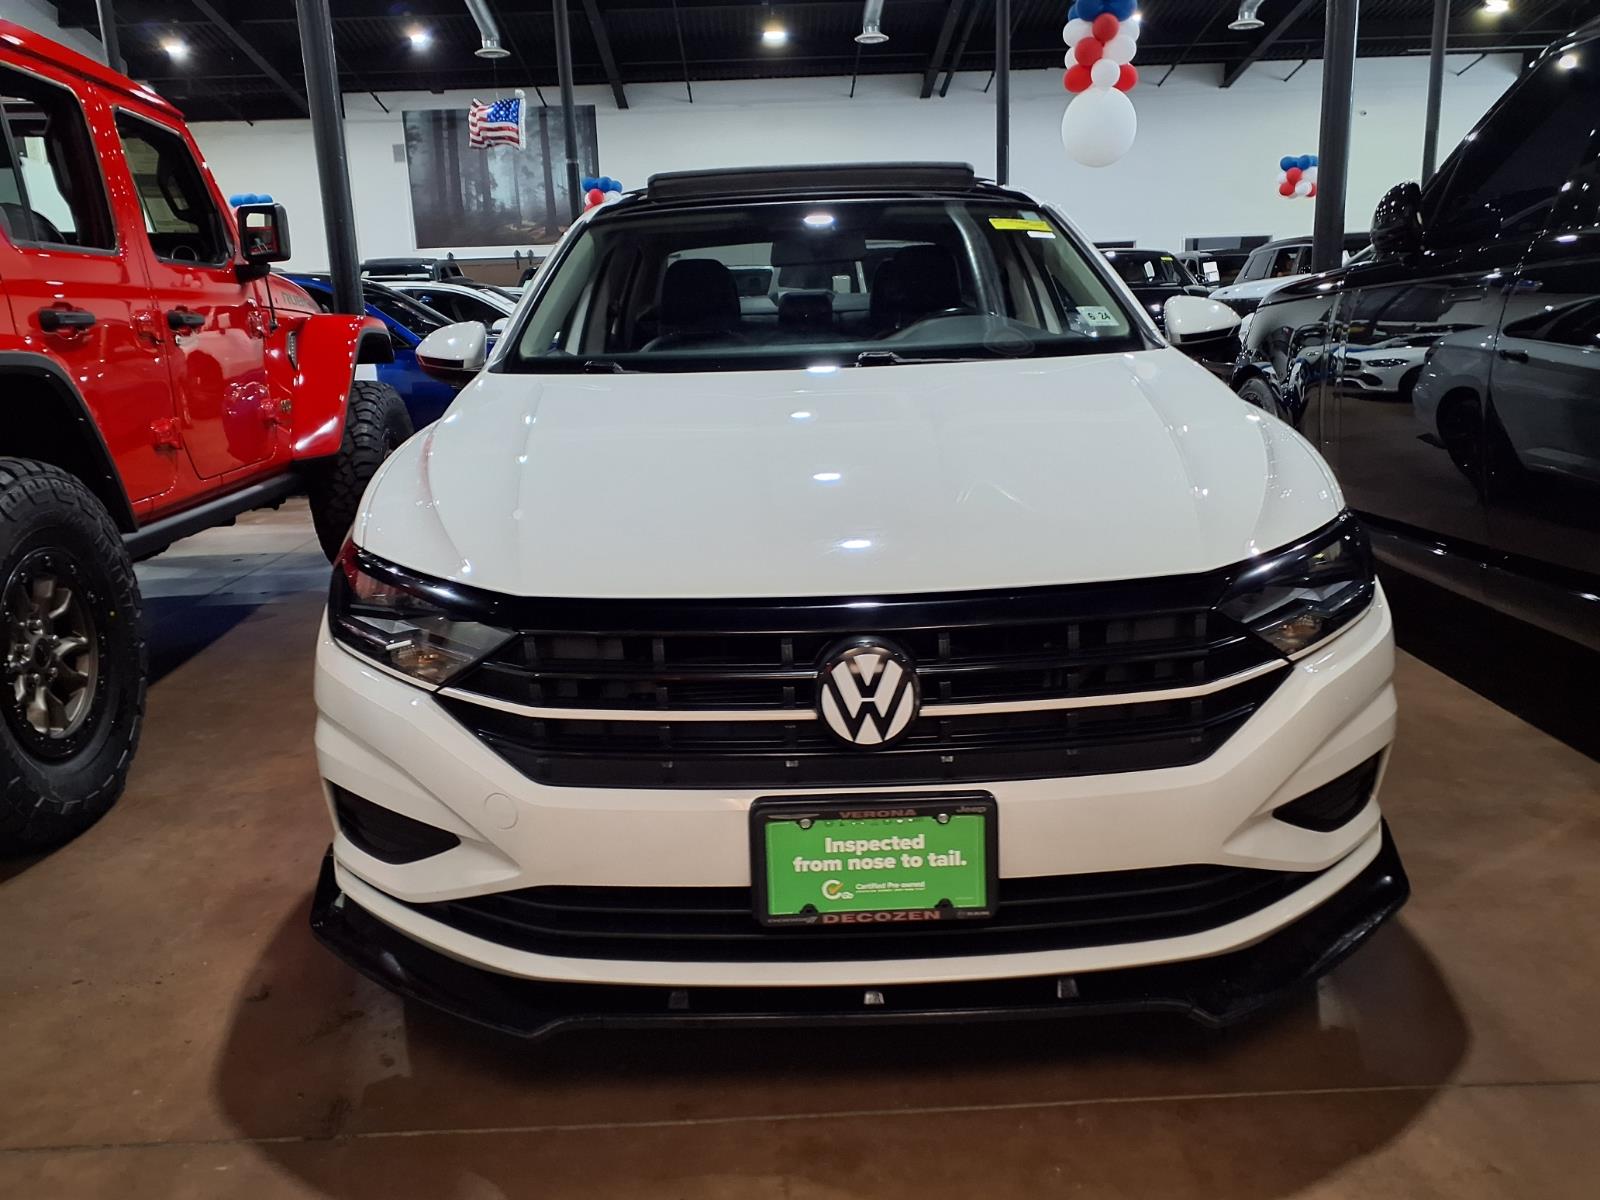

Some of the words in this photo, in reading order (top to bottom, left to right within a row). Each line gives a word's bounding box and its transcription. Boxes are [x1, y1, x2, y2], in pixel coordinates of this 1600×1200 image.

[838, 809, 917, 819] VERONA
[825, 833, 925, 856] Inspected
[793, 856, 843, 873] from
[847, 857, 897, 871] nose
[900, 853, 924, 869] to
[927, 849, 968, 868] tail.
[822, 910, 941, 924] DECOZEN
